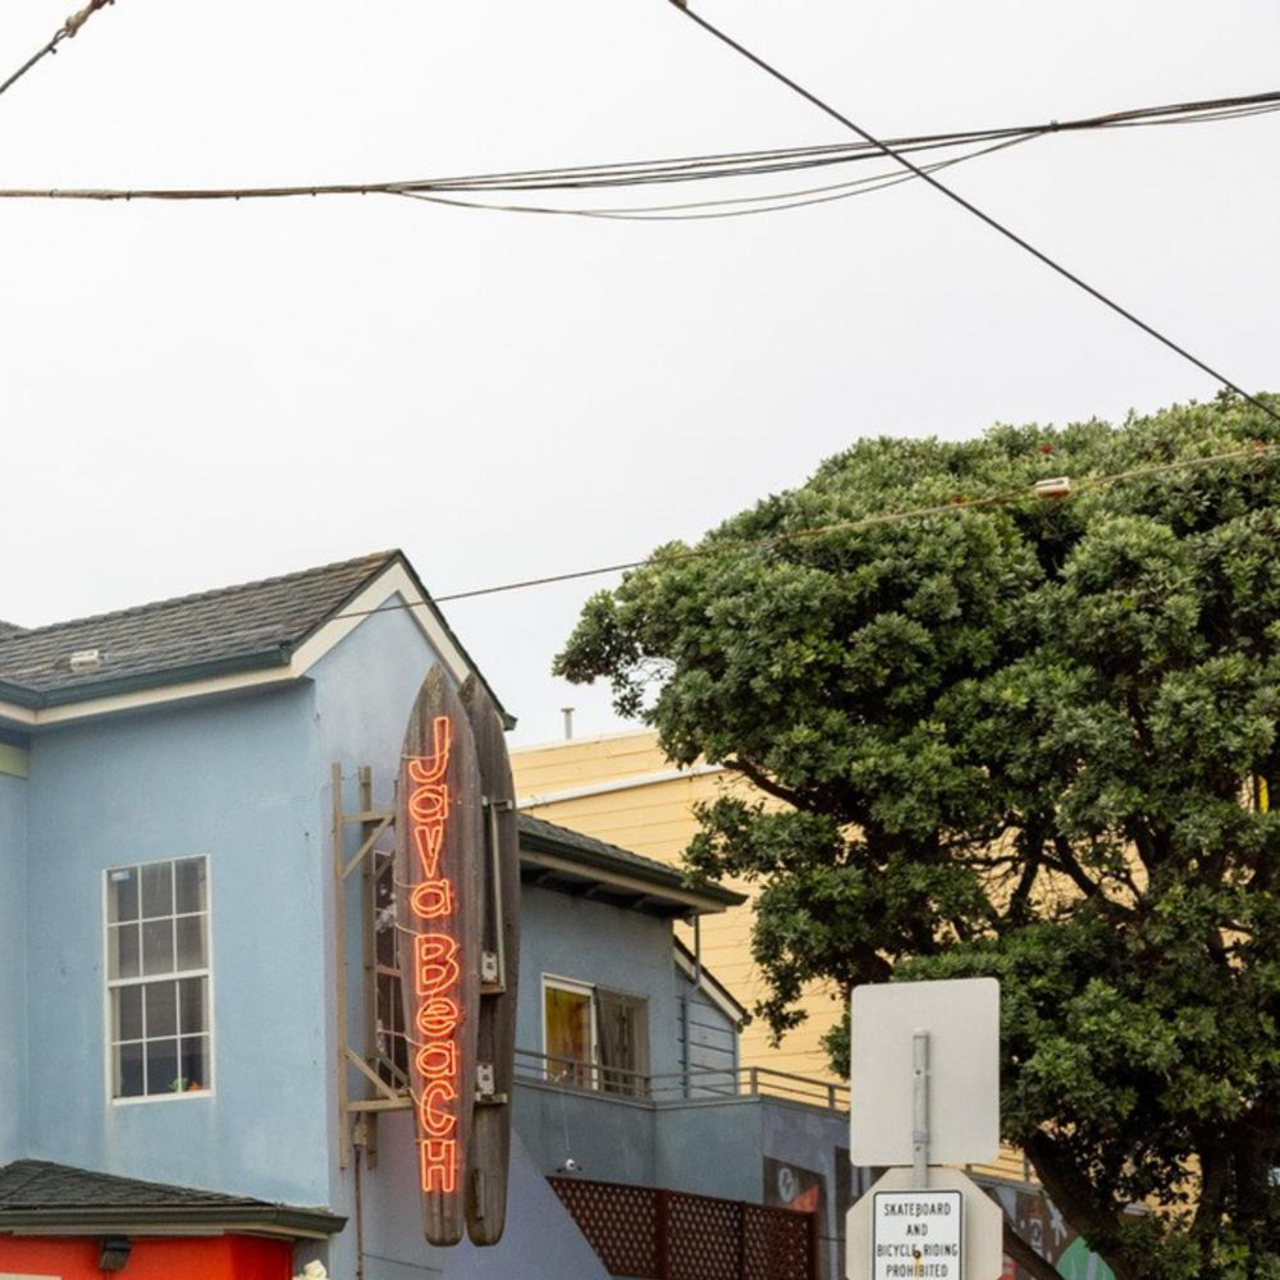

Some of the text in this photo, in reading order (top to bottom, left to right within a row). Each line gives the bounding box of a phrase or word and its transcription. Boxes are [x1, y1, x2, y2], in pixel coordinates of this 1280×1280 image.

[884, 1203, 951, 1217] SKATEBOARD
[906, 1223, 928, 1236] AND
[923, 1243, 958, 1257] RIDING
[886, 1264, 949, 1278] PROHIBITED
